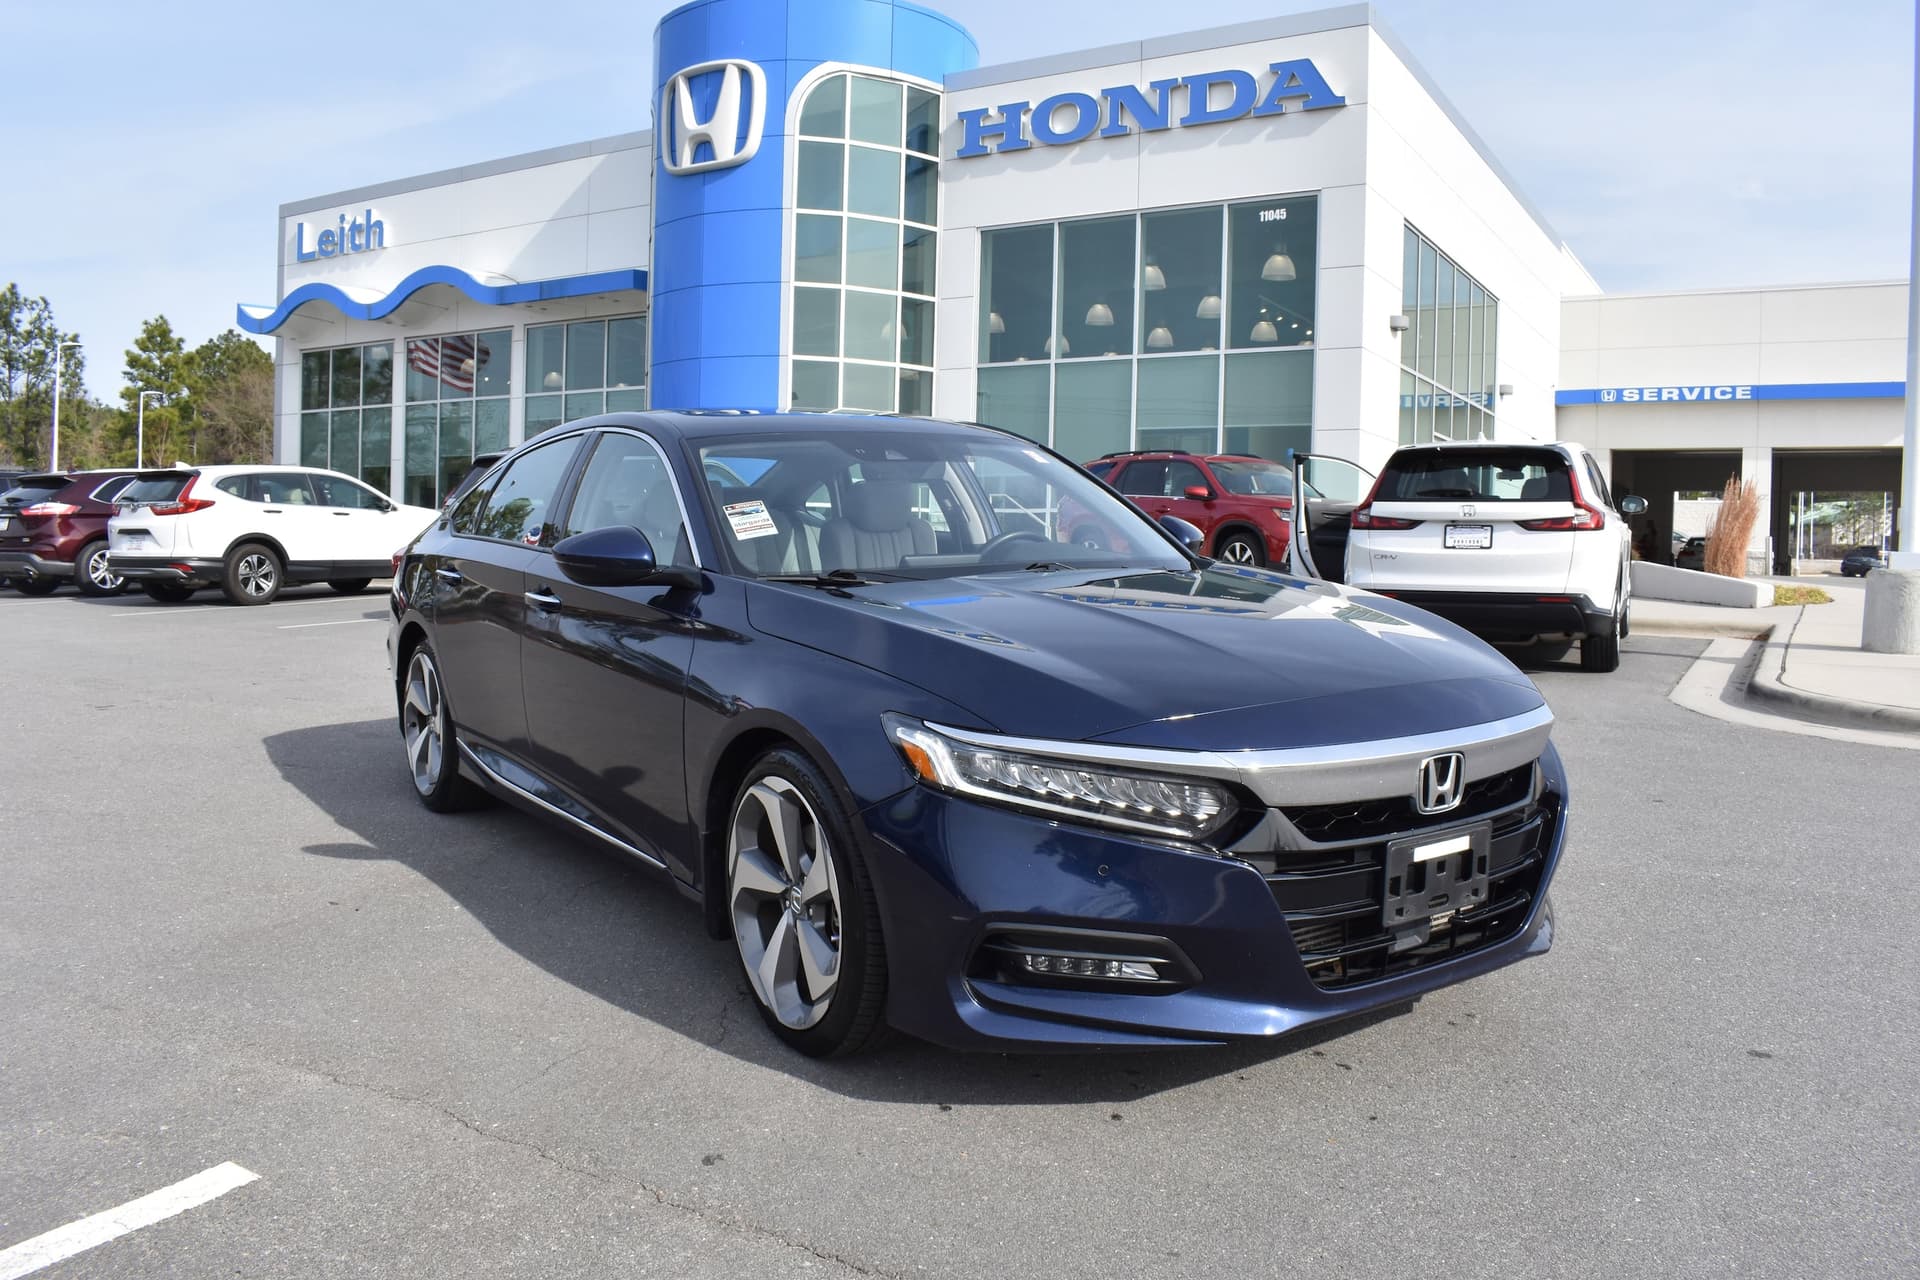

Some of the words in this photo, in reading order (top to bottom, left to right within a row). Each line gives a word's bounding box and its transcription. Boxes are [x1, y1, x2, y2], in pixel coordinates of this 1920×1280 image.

[957, 58, 1346, 158] HONDA
[1259, 208, 1287, 222] 11045
[296, 208, 384, 262] Leith
[1622, 386, 1752, 401] SERVICE
